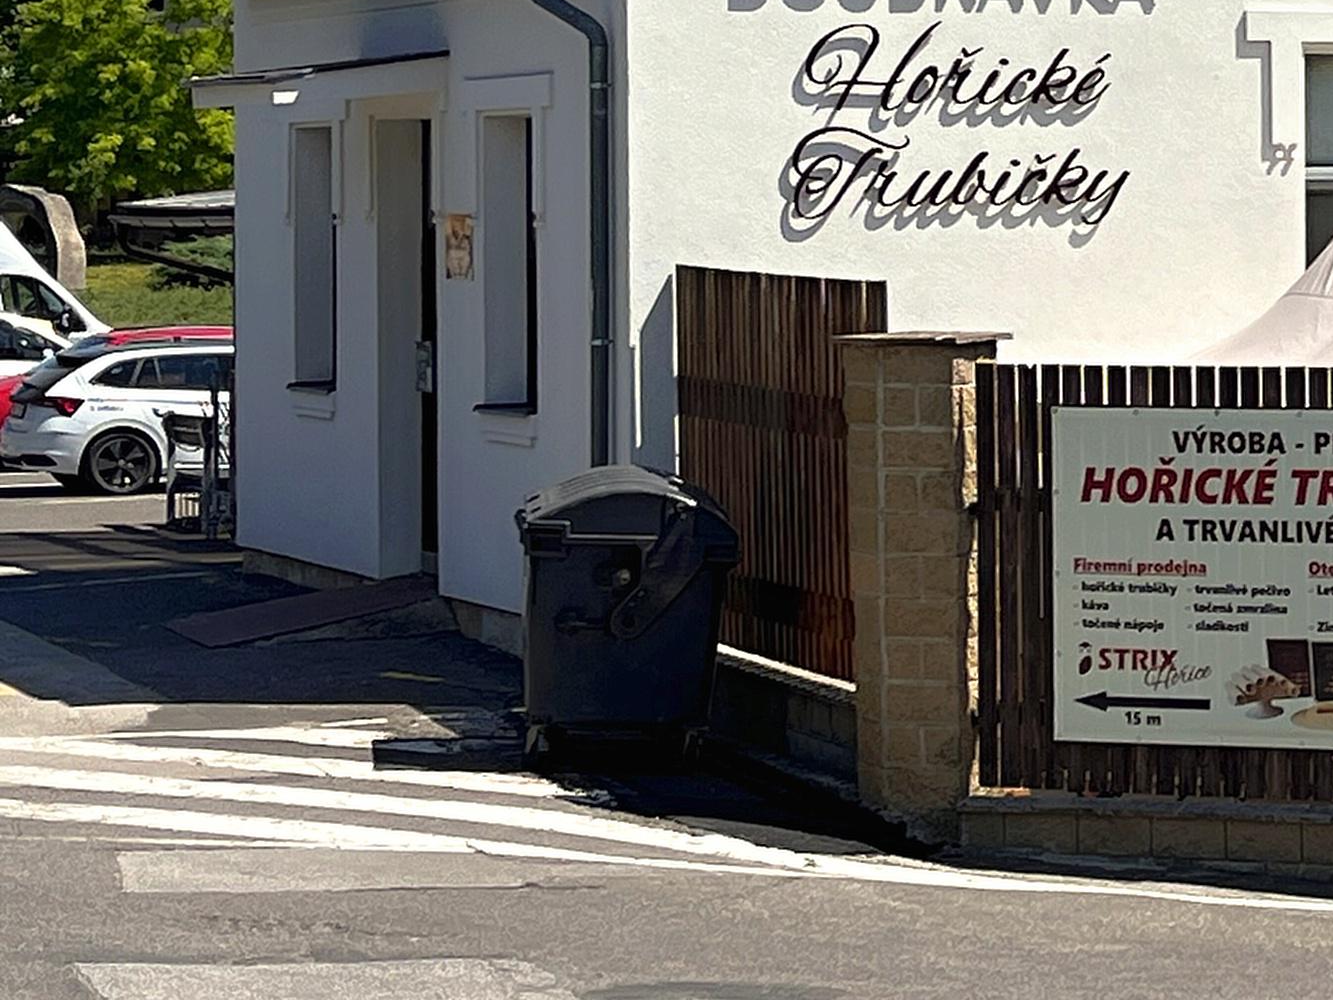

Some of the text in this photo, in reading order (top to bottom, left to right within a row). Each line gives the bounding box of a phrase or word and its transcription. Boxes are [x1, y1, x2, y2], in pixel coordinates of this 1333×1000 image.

[804, 21, 1113, 112] Hořické
[792, 126, 1132, 226] Trubičky
[1172, 424, 1286, 455] VÝROBA
[1080, 456, 1278, 506] HOŘICKÉ
[1155, 518, 1175, 542] A
[1073, 556, 1207, 578] Firemní prodejna
[1081, 599, 1110, 611] káva
[1098, 647, 1178, 672] STRIX
[1124, 710, 1162, 726] 15 m
